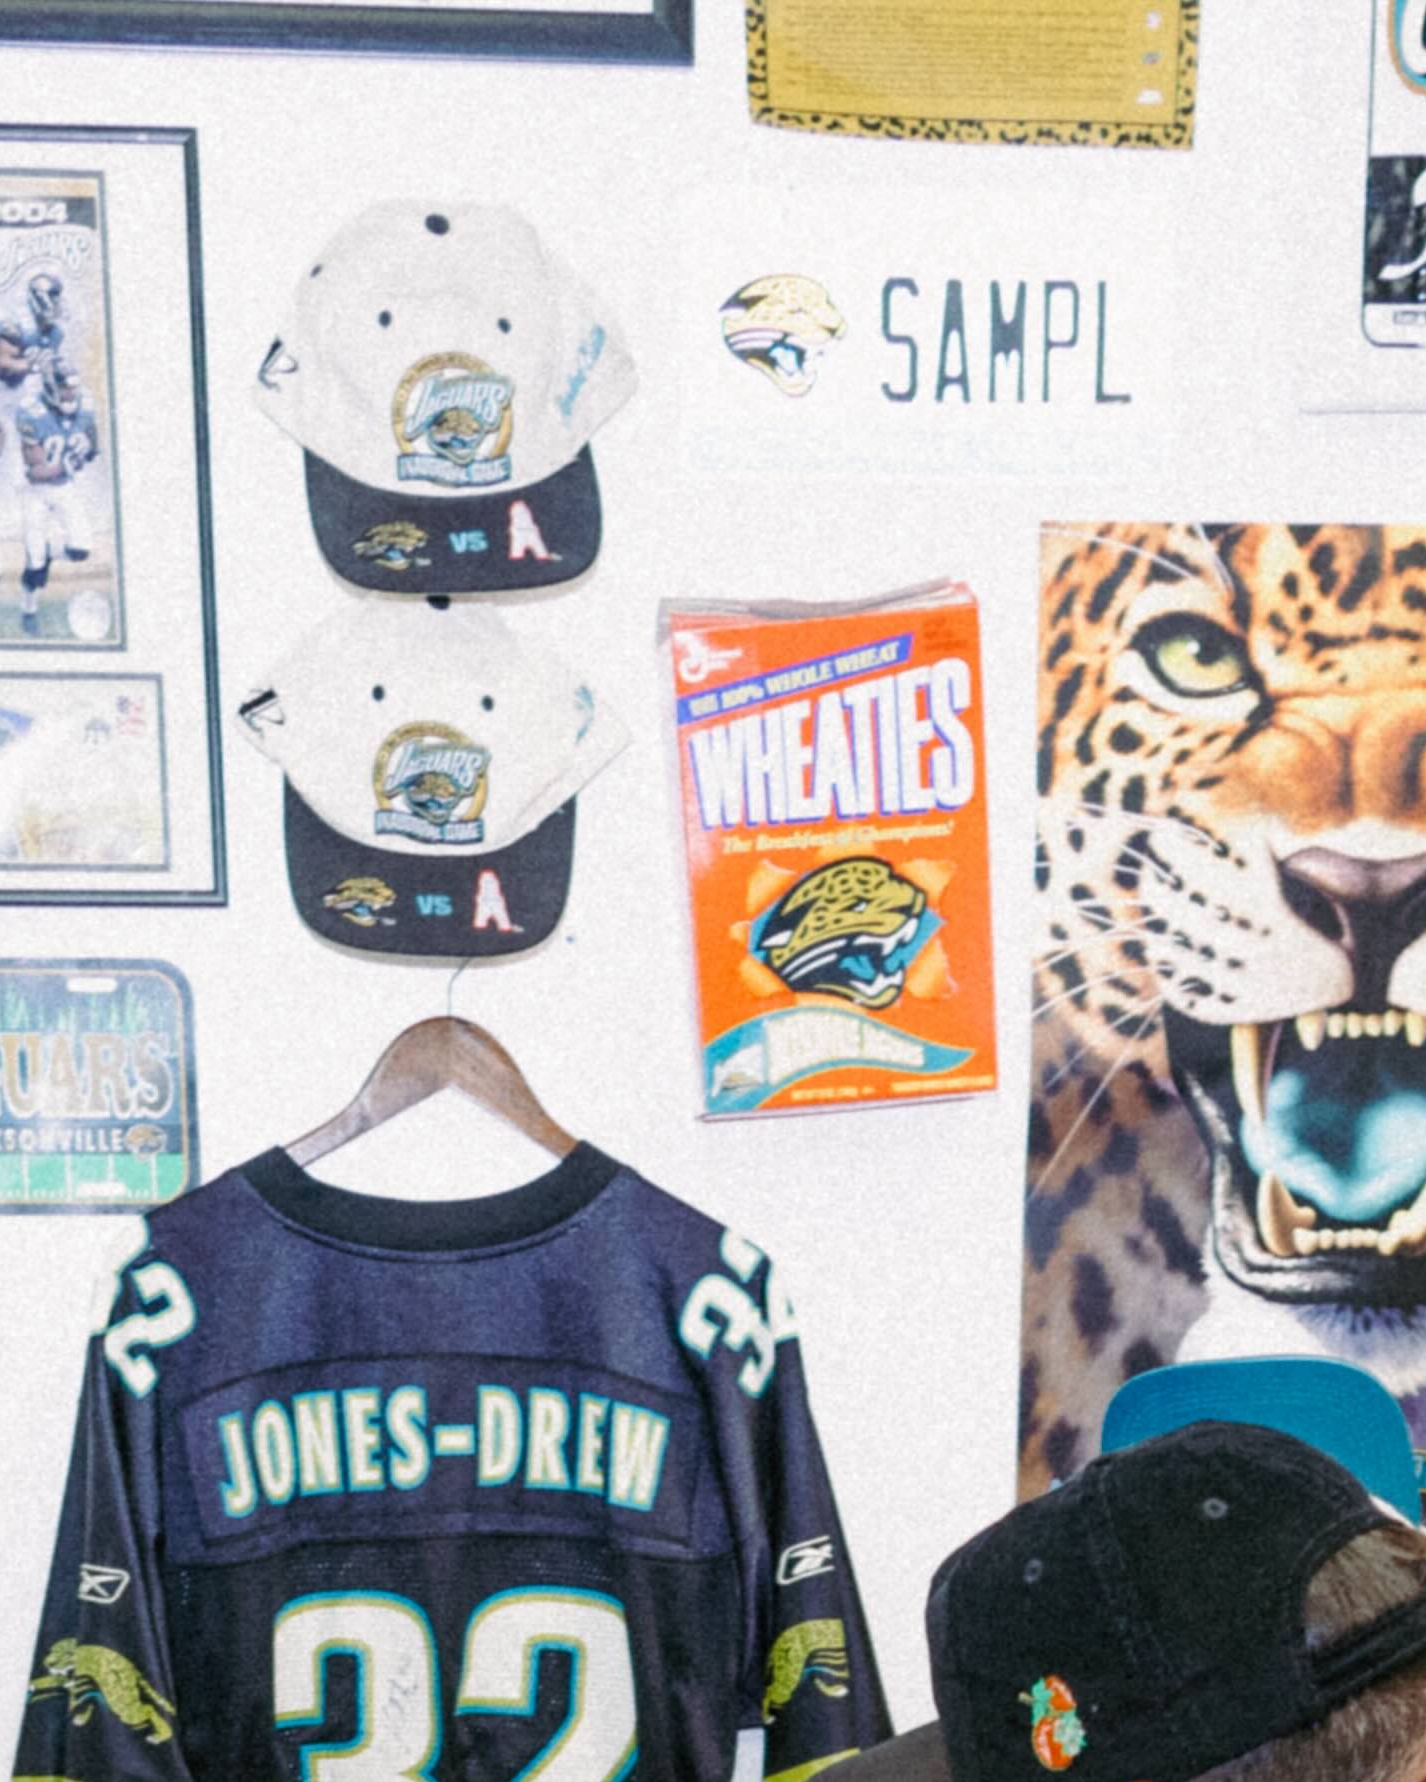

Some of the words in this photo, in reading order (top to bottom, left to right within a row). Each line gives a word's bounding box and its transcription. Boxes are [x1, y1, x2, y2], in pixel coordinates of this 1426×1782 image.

[882, 278, 1132, 403] SAMPL
[405, 376, 511, 436] JAGUARS
[447, 528, 490, 555] VS
[385, 745, 486, 794] JAGUARS
[688, 657, 975, 831] WHEATIES
[414, 894, 454, 917] VS
[217, 1385, 670, 1519] JONES-DREW
